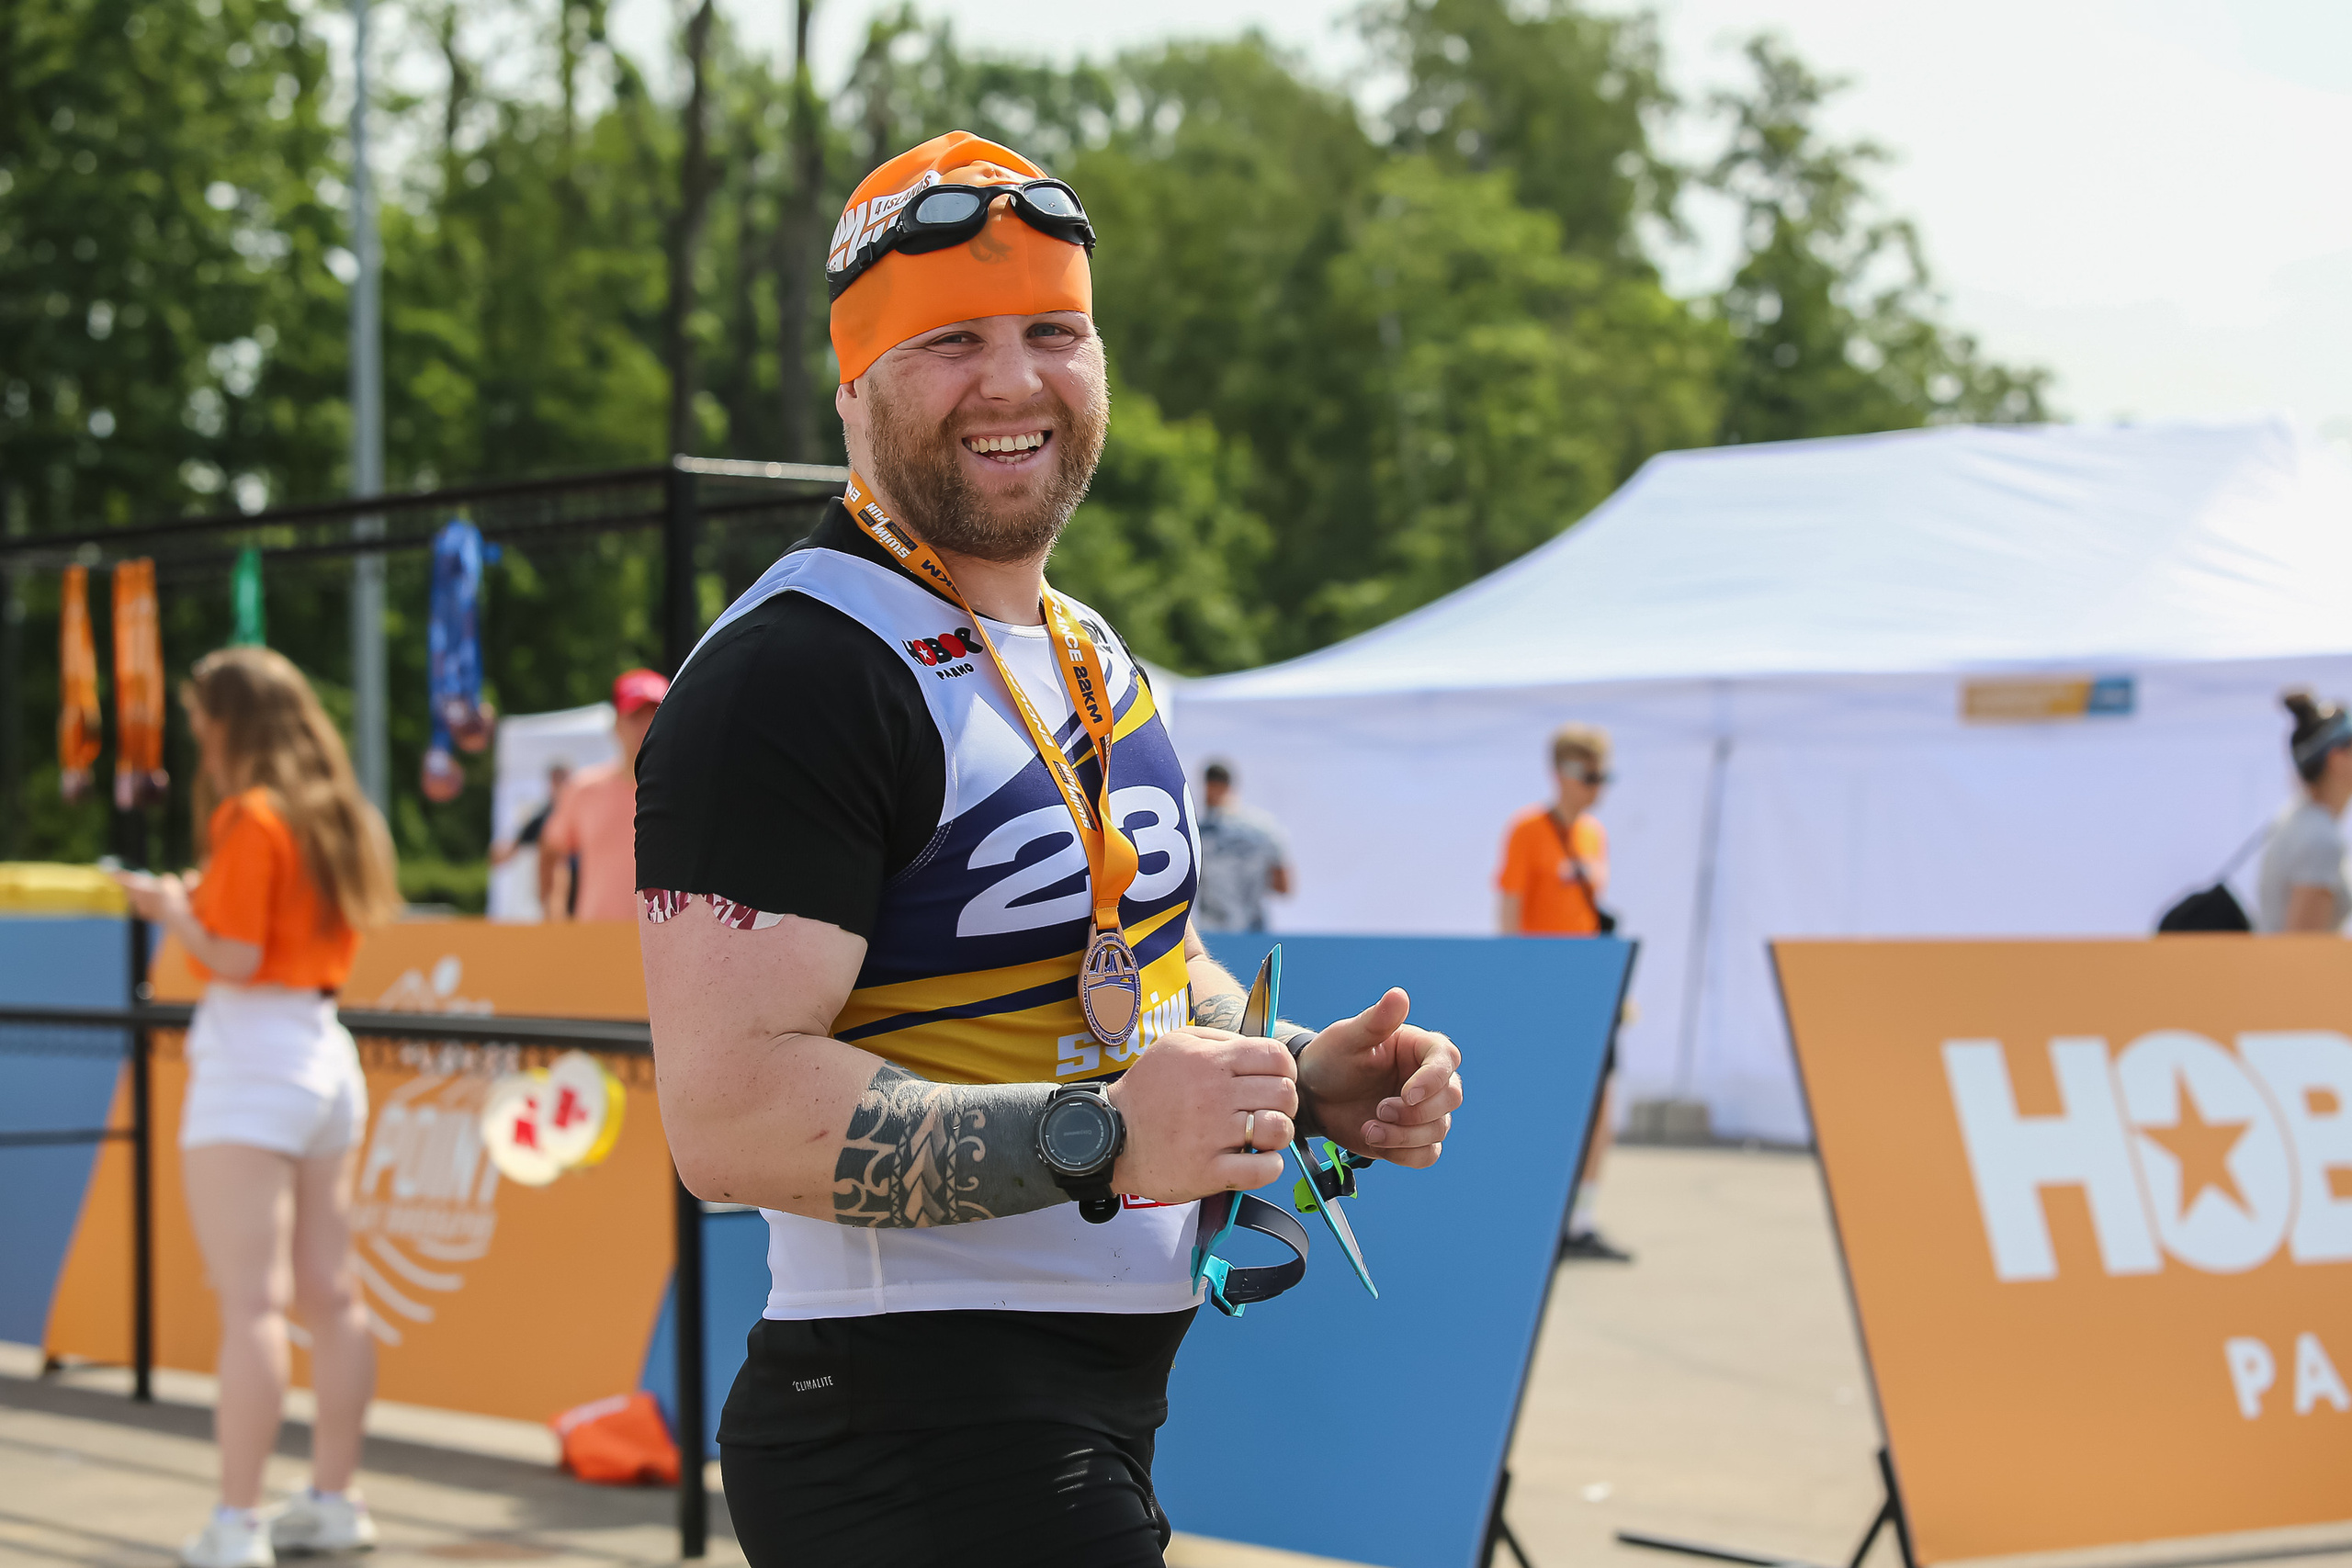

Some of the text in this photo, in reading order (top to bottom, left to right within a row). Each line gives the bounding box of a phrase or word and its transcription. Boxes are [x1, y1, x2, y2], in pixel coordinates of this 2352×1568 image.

[875, 175, 932, 215] 4 ISLANDS
[1051, 599, 1103, 725] RANCE 22KM
[956, 783, 1203, 938] 23
